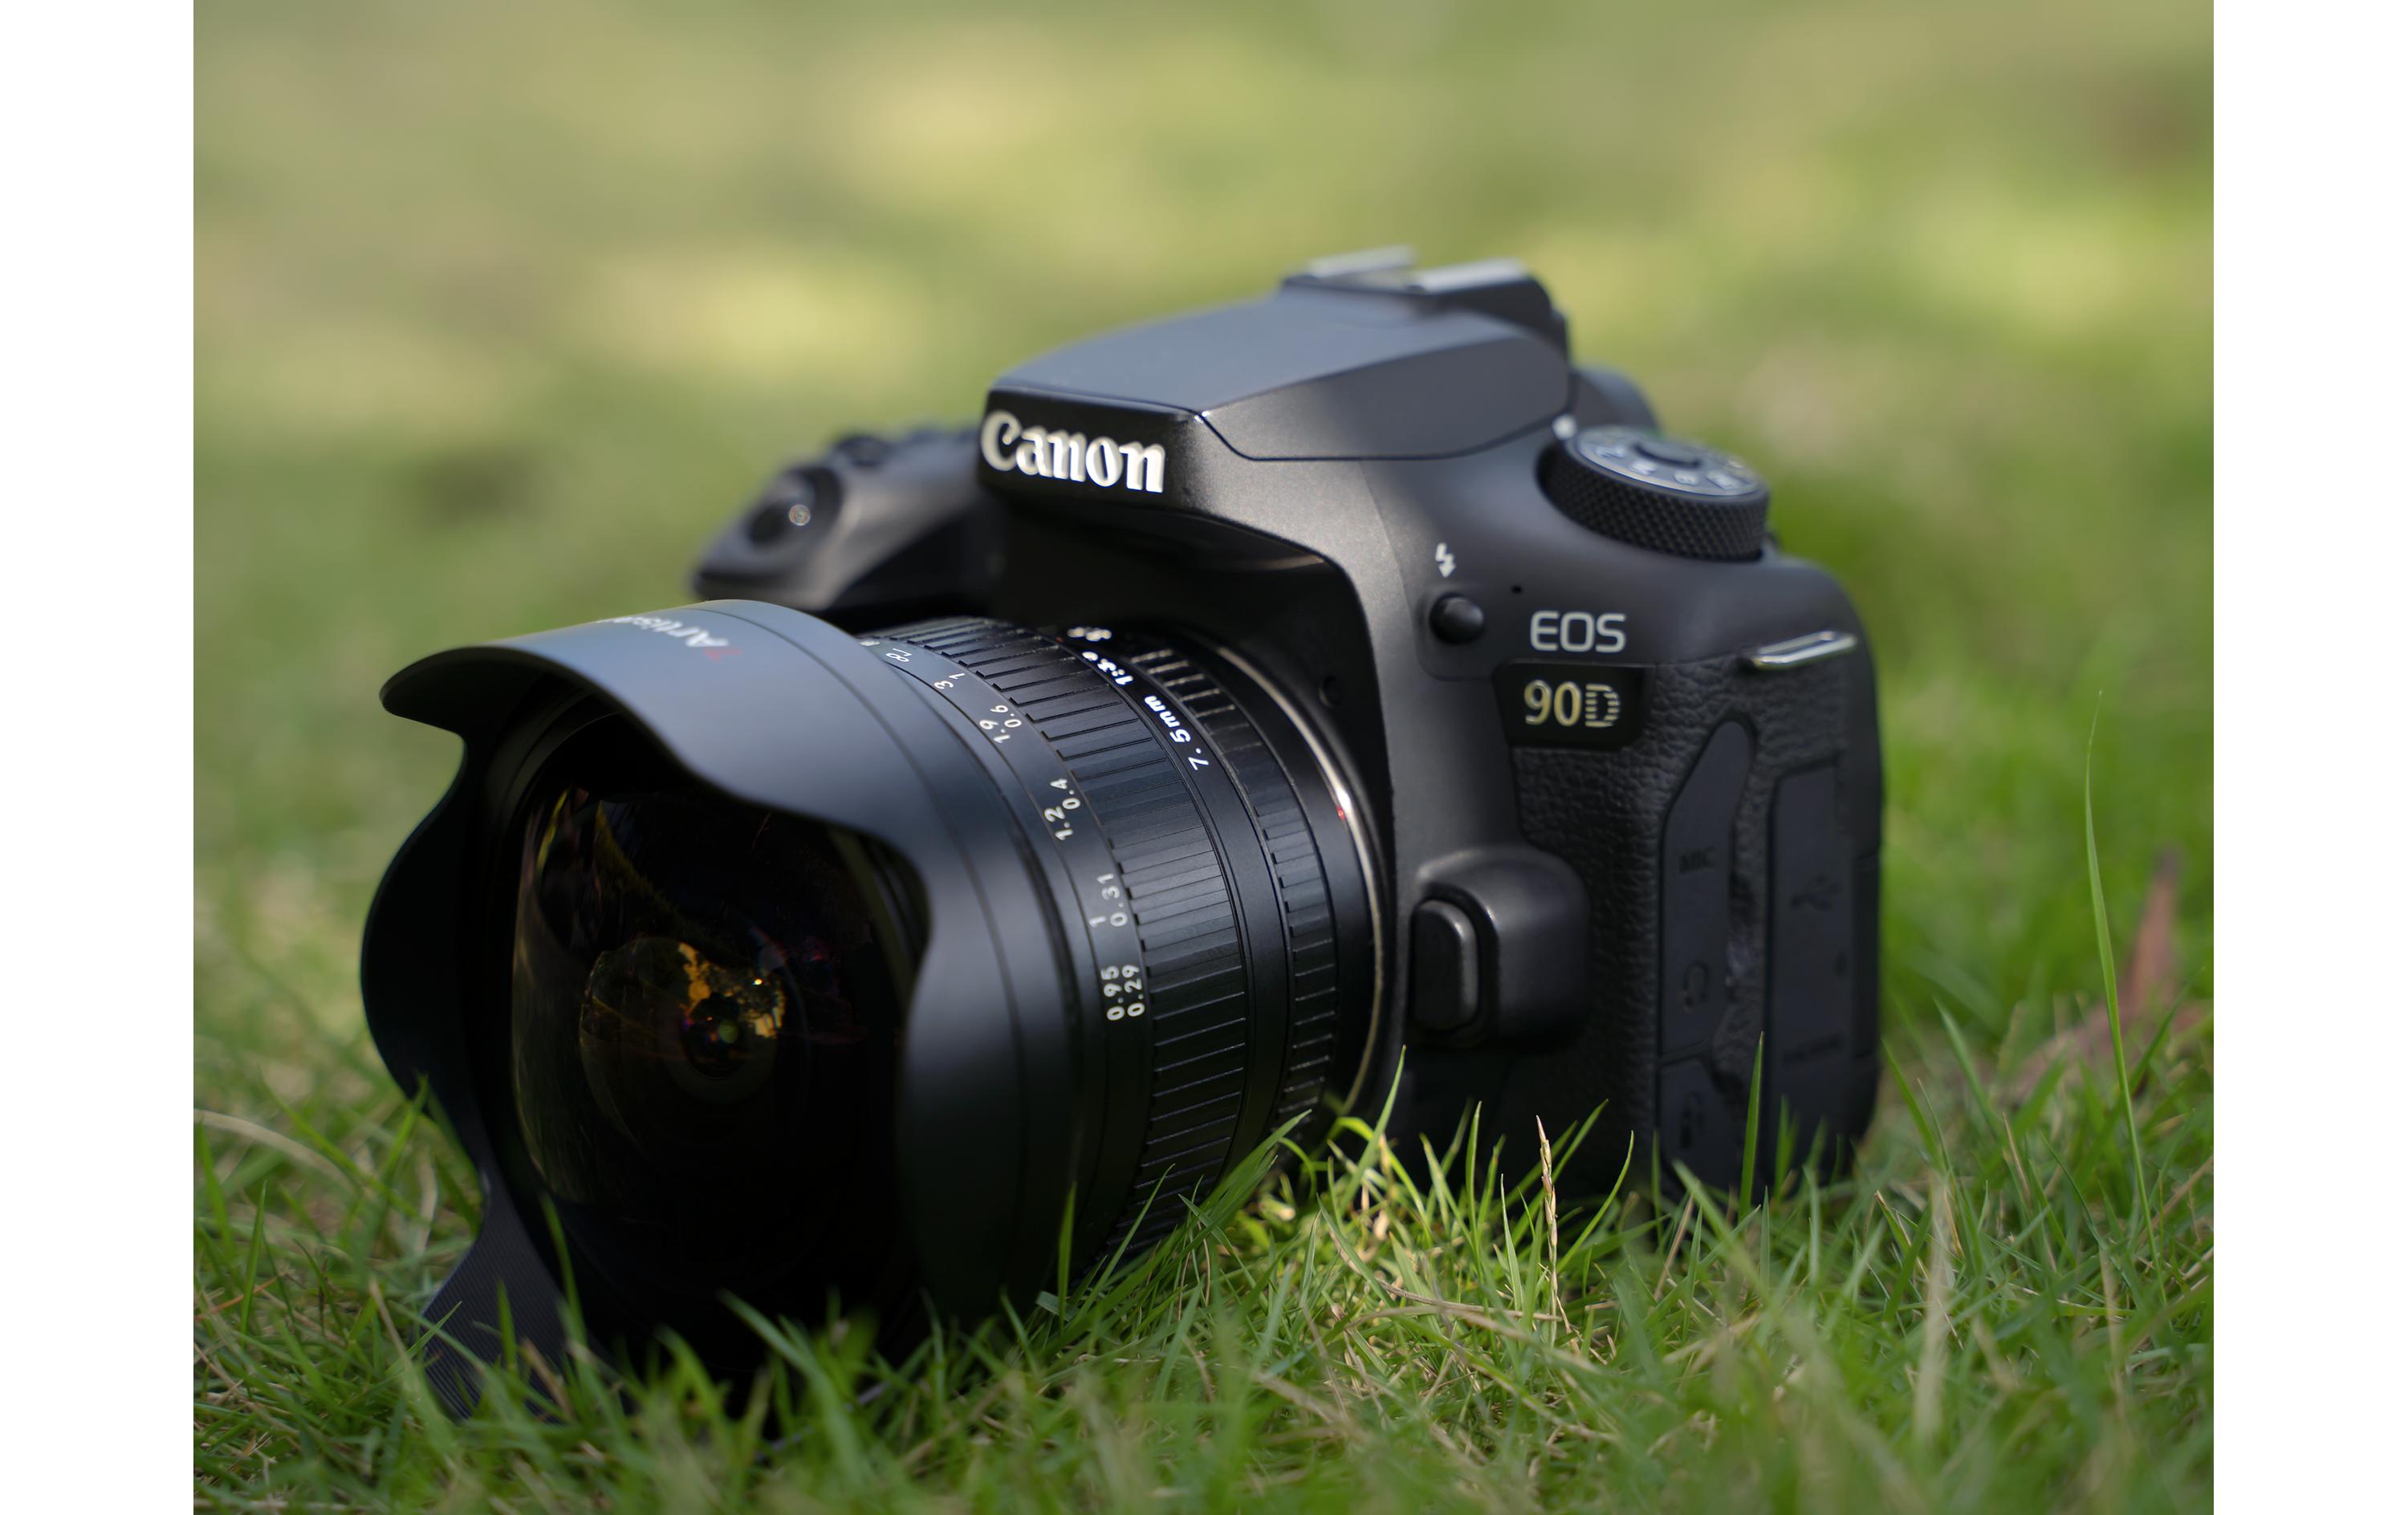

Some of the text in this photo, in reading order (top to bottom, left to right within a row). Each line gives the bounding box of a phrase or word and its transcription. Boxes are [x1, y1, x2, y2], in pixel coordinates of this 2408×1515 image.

[980, 410, 1165, 493] Canon
[1530, 611, 1626, 653] EOS
[1144, 695, 1210, 771] 7.5mm
[1524, 679, 1621, 728] 90D
[934, 680, 1125, 1021] 0.95 1 1.2 1.9 3
[949, 672, 1145, 1017] 0.29 0.31 0.4 0.6 1
